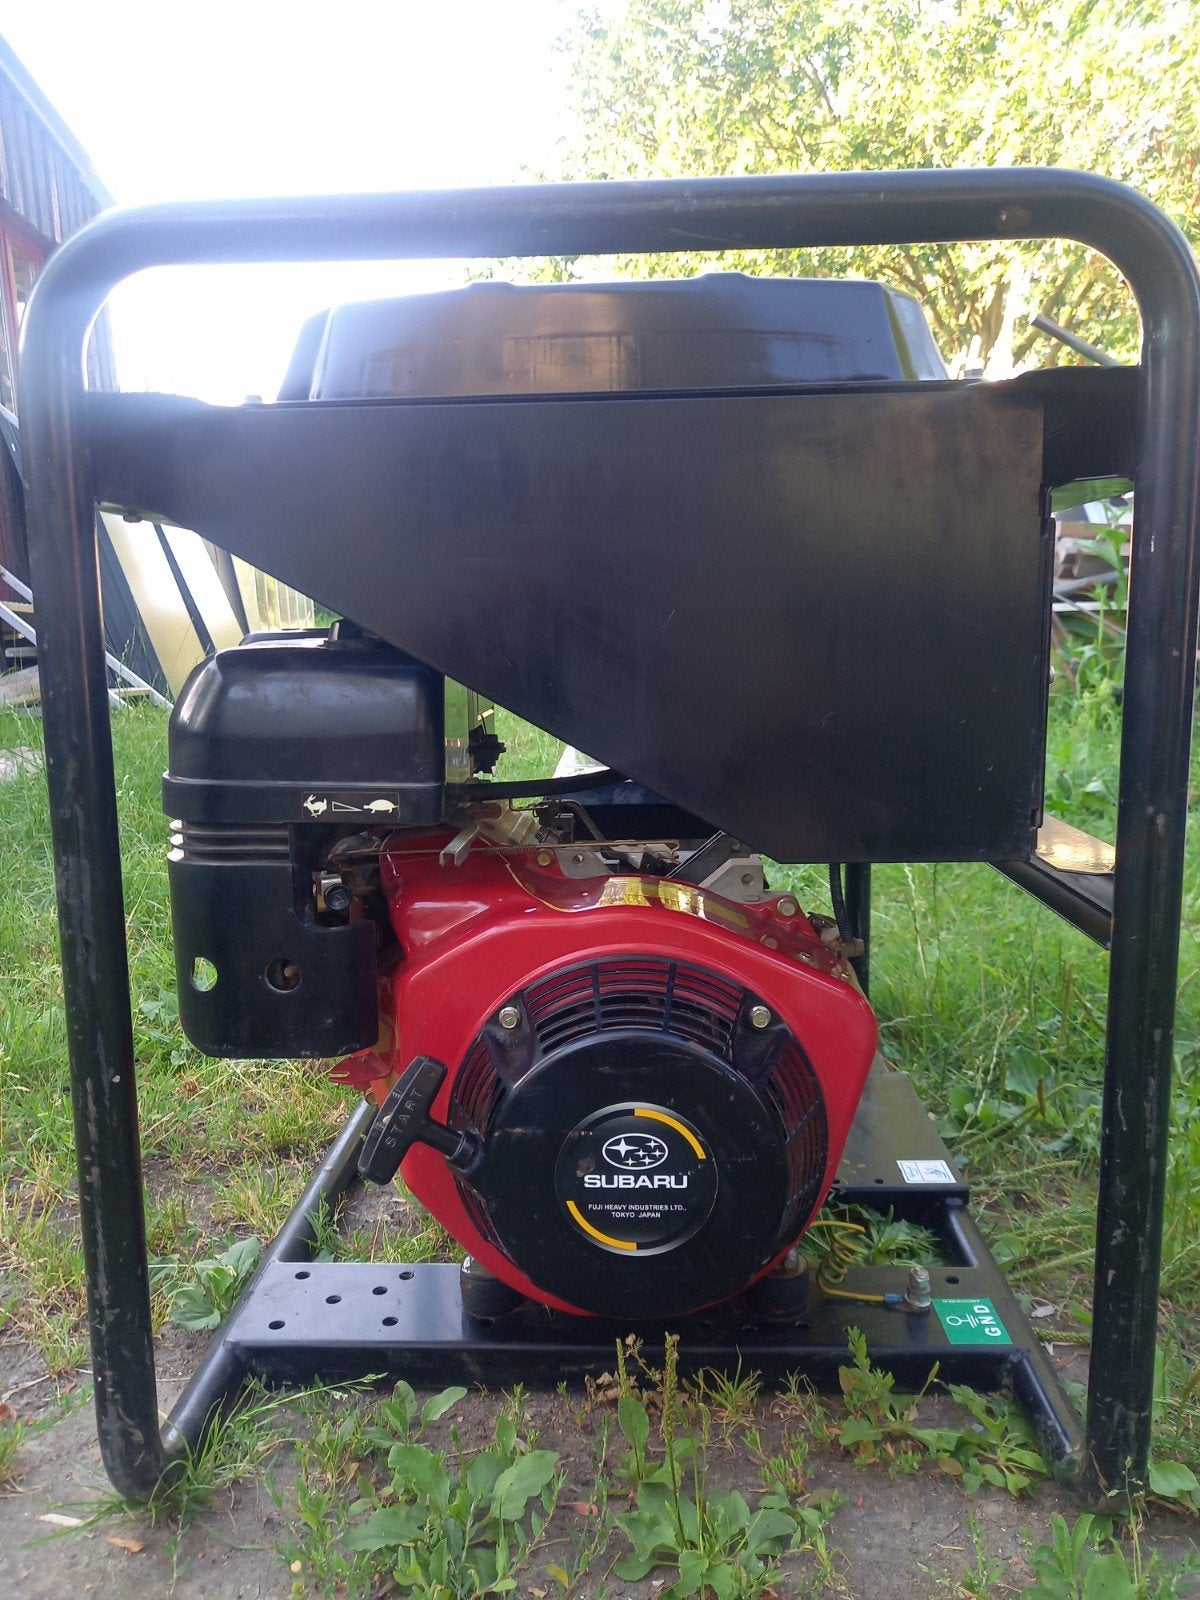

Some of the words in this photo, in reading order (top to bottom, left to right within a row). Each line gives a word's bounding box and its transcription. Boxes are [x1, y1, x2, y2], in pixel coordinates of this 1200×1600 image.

[385, 1087, 422, 1148] START
[583, 1174, 688, 1189] SUBARU
[973, 1305, 1002, 1337] GND
